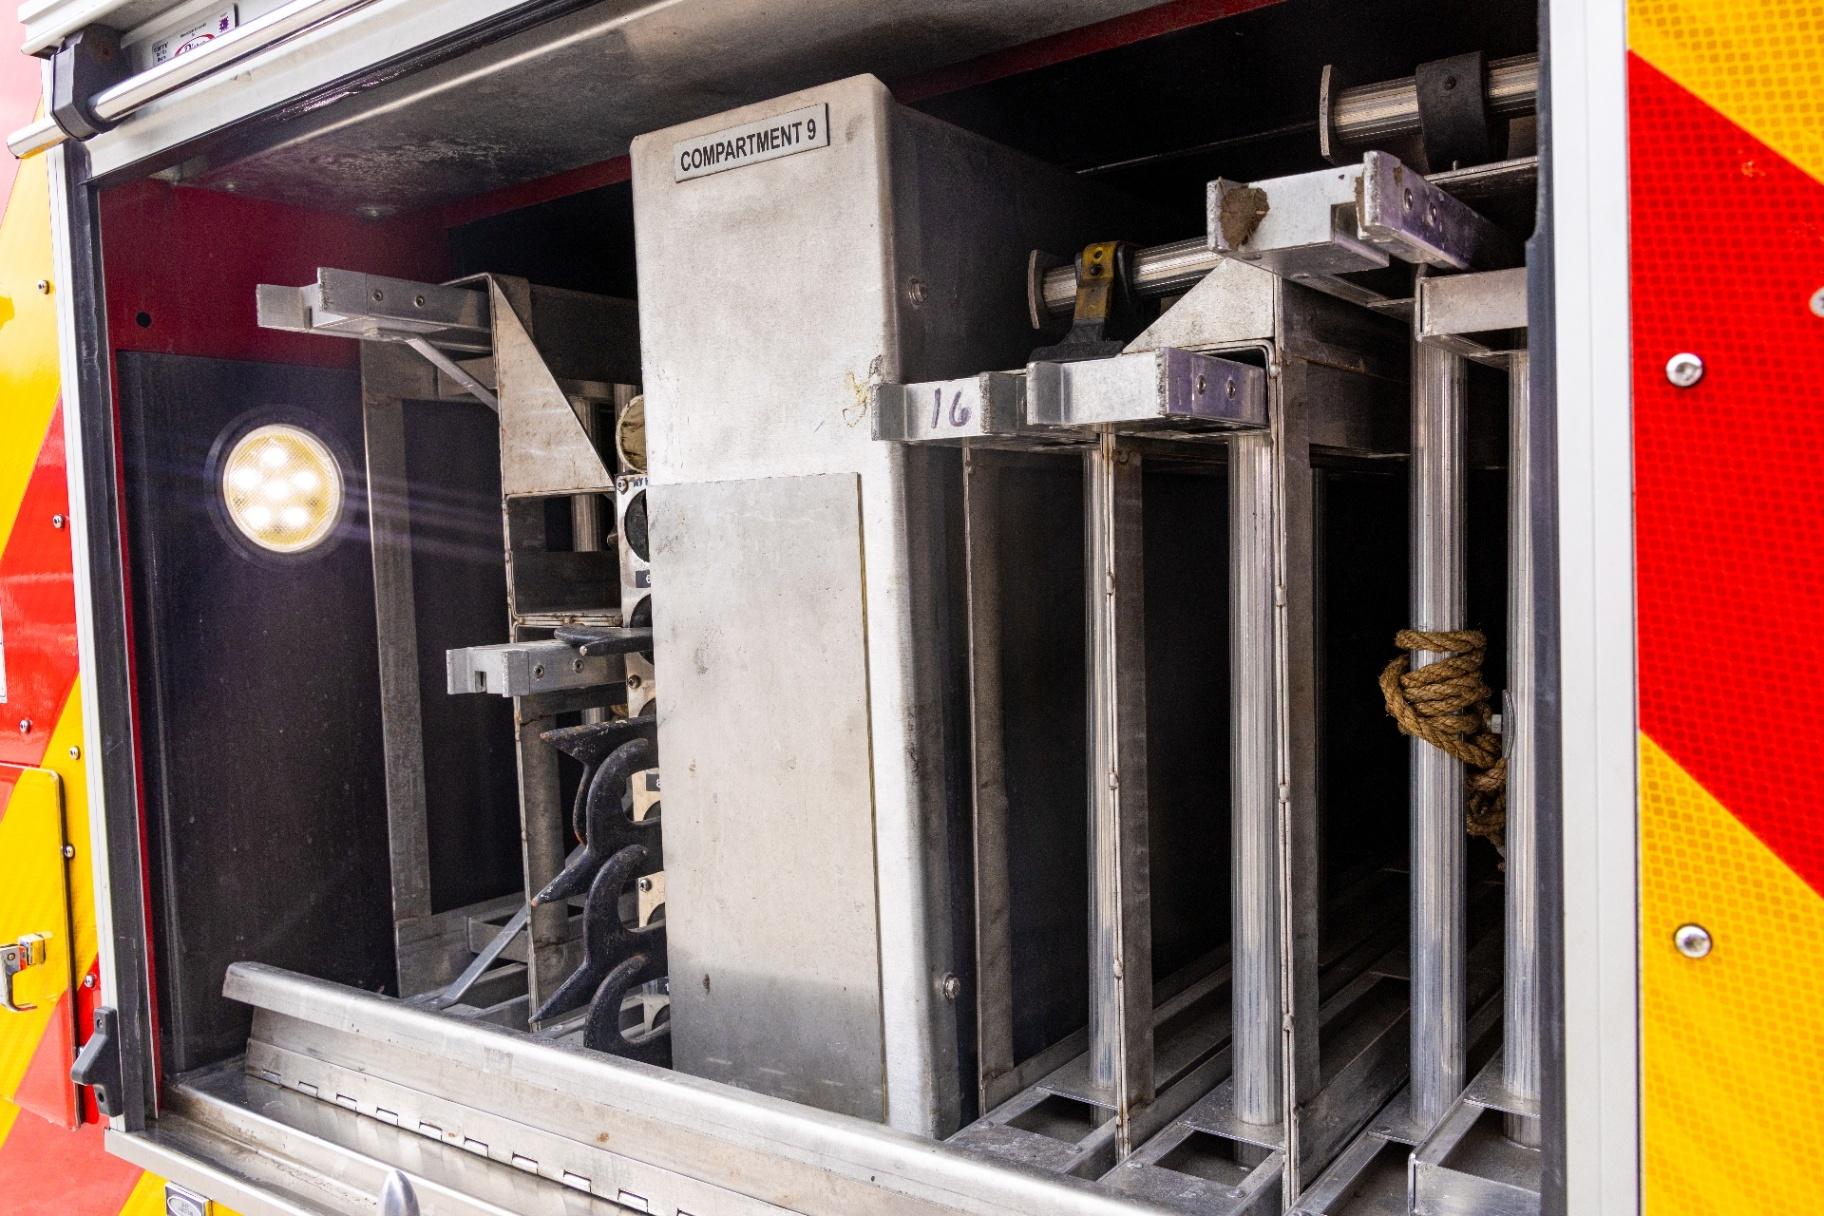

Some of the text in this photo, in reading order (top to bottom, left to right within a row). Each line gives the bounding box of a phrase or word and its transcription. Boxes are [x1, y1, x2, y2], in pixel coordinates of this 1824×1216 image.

[680, 118, 817, 172] COMPARTMENT 9
[931, 387, 972, 429] 16
